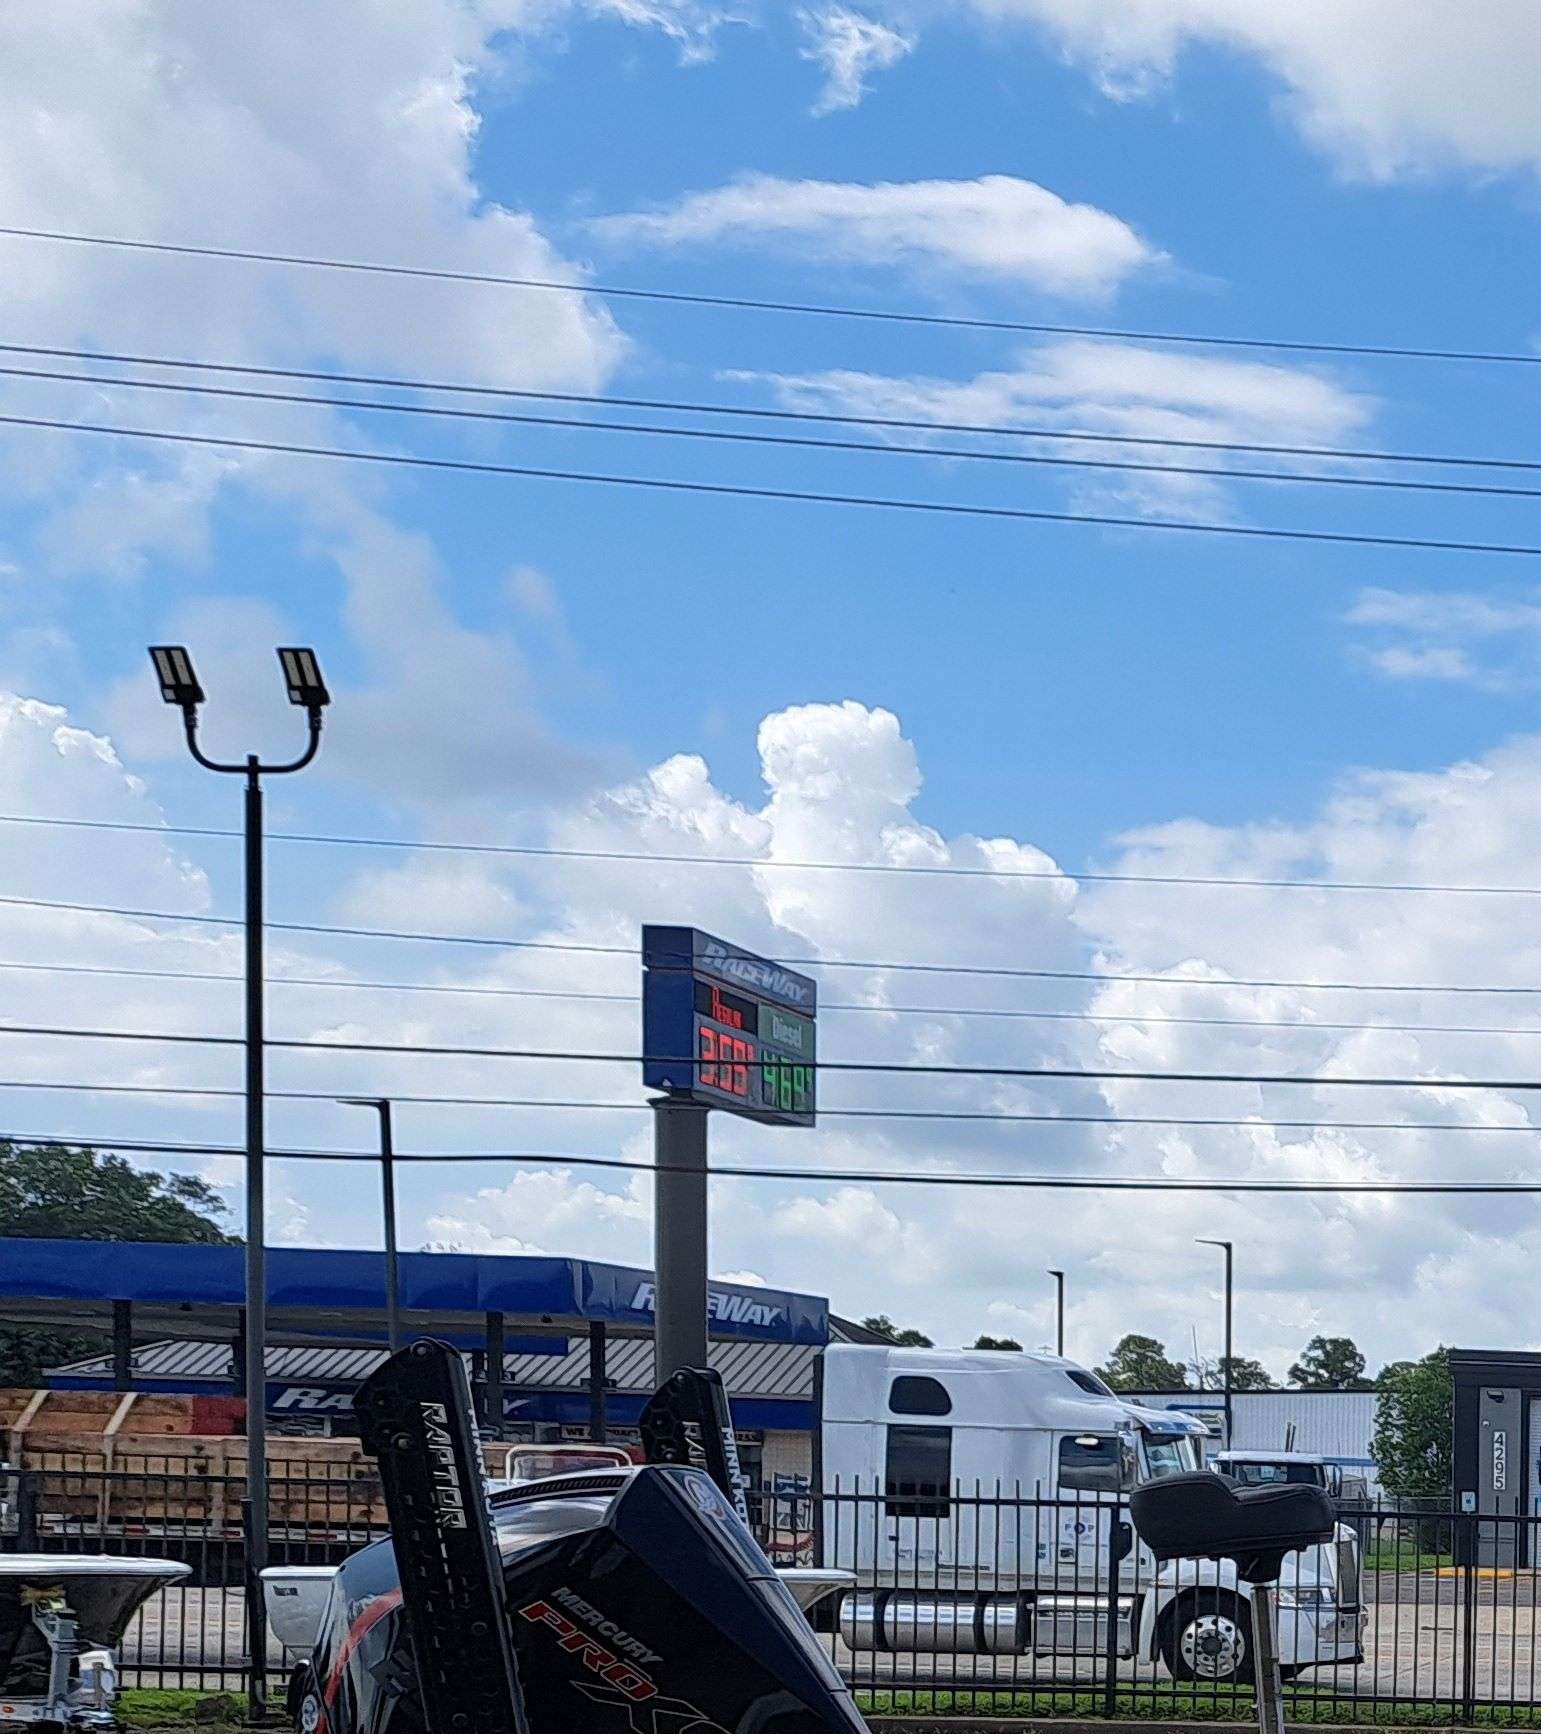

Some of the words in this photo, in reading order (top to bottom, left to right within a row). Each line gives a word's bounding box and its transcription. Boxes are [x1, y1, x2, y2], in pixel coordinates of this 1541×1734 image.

[631, 1282, 782, 1326] REWAY
[419, 1402, 467, 1528] RAPTOR
[1494, 1433, 1505, 1489] 4295
[517, 1600, 659, 1701] PRO
[551, 1586, 664, 1663] MERCURY
